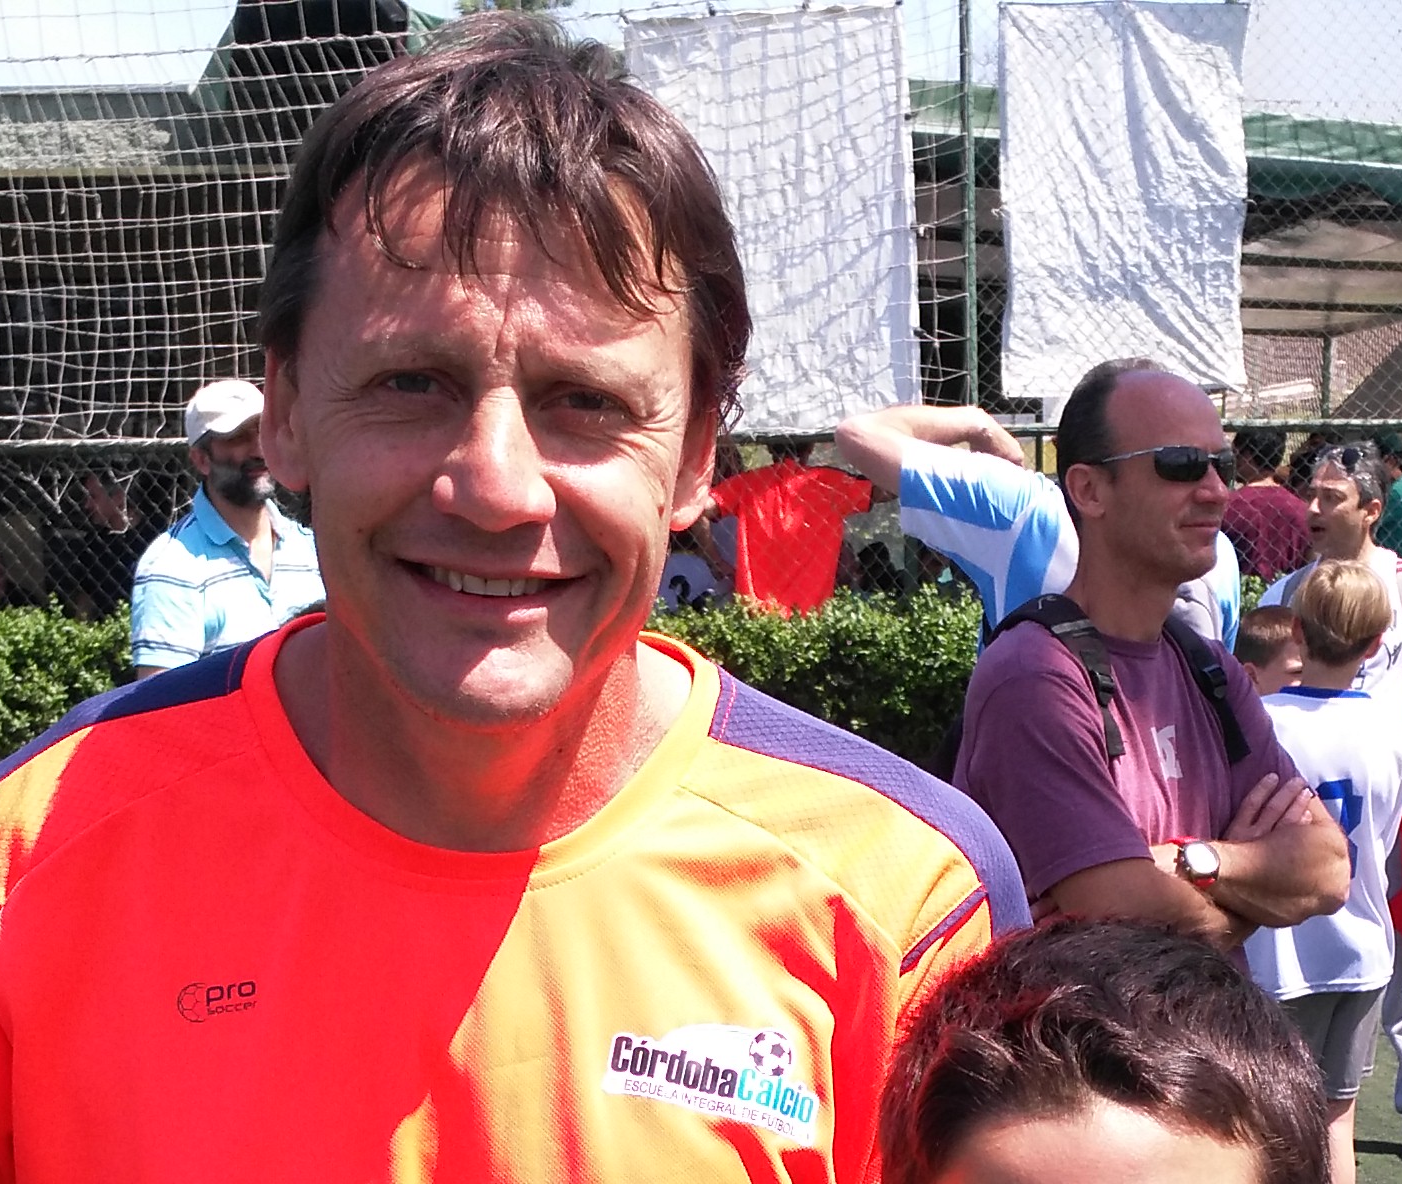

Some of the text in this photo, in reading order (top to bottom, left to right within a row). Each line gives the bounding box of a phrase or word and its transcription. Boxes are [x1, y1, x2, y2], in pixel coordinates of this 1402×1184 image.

[206, 981, 256, 1006] pro
[207, 1000, 257, 1015] soccer
[611, 1036, 814, 1123] CórdobaCalcio
[681, 1093, 737, 1116] INTEGRAL
[741, 1106, 759, 1121] DE
